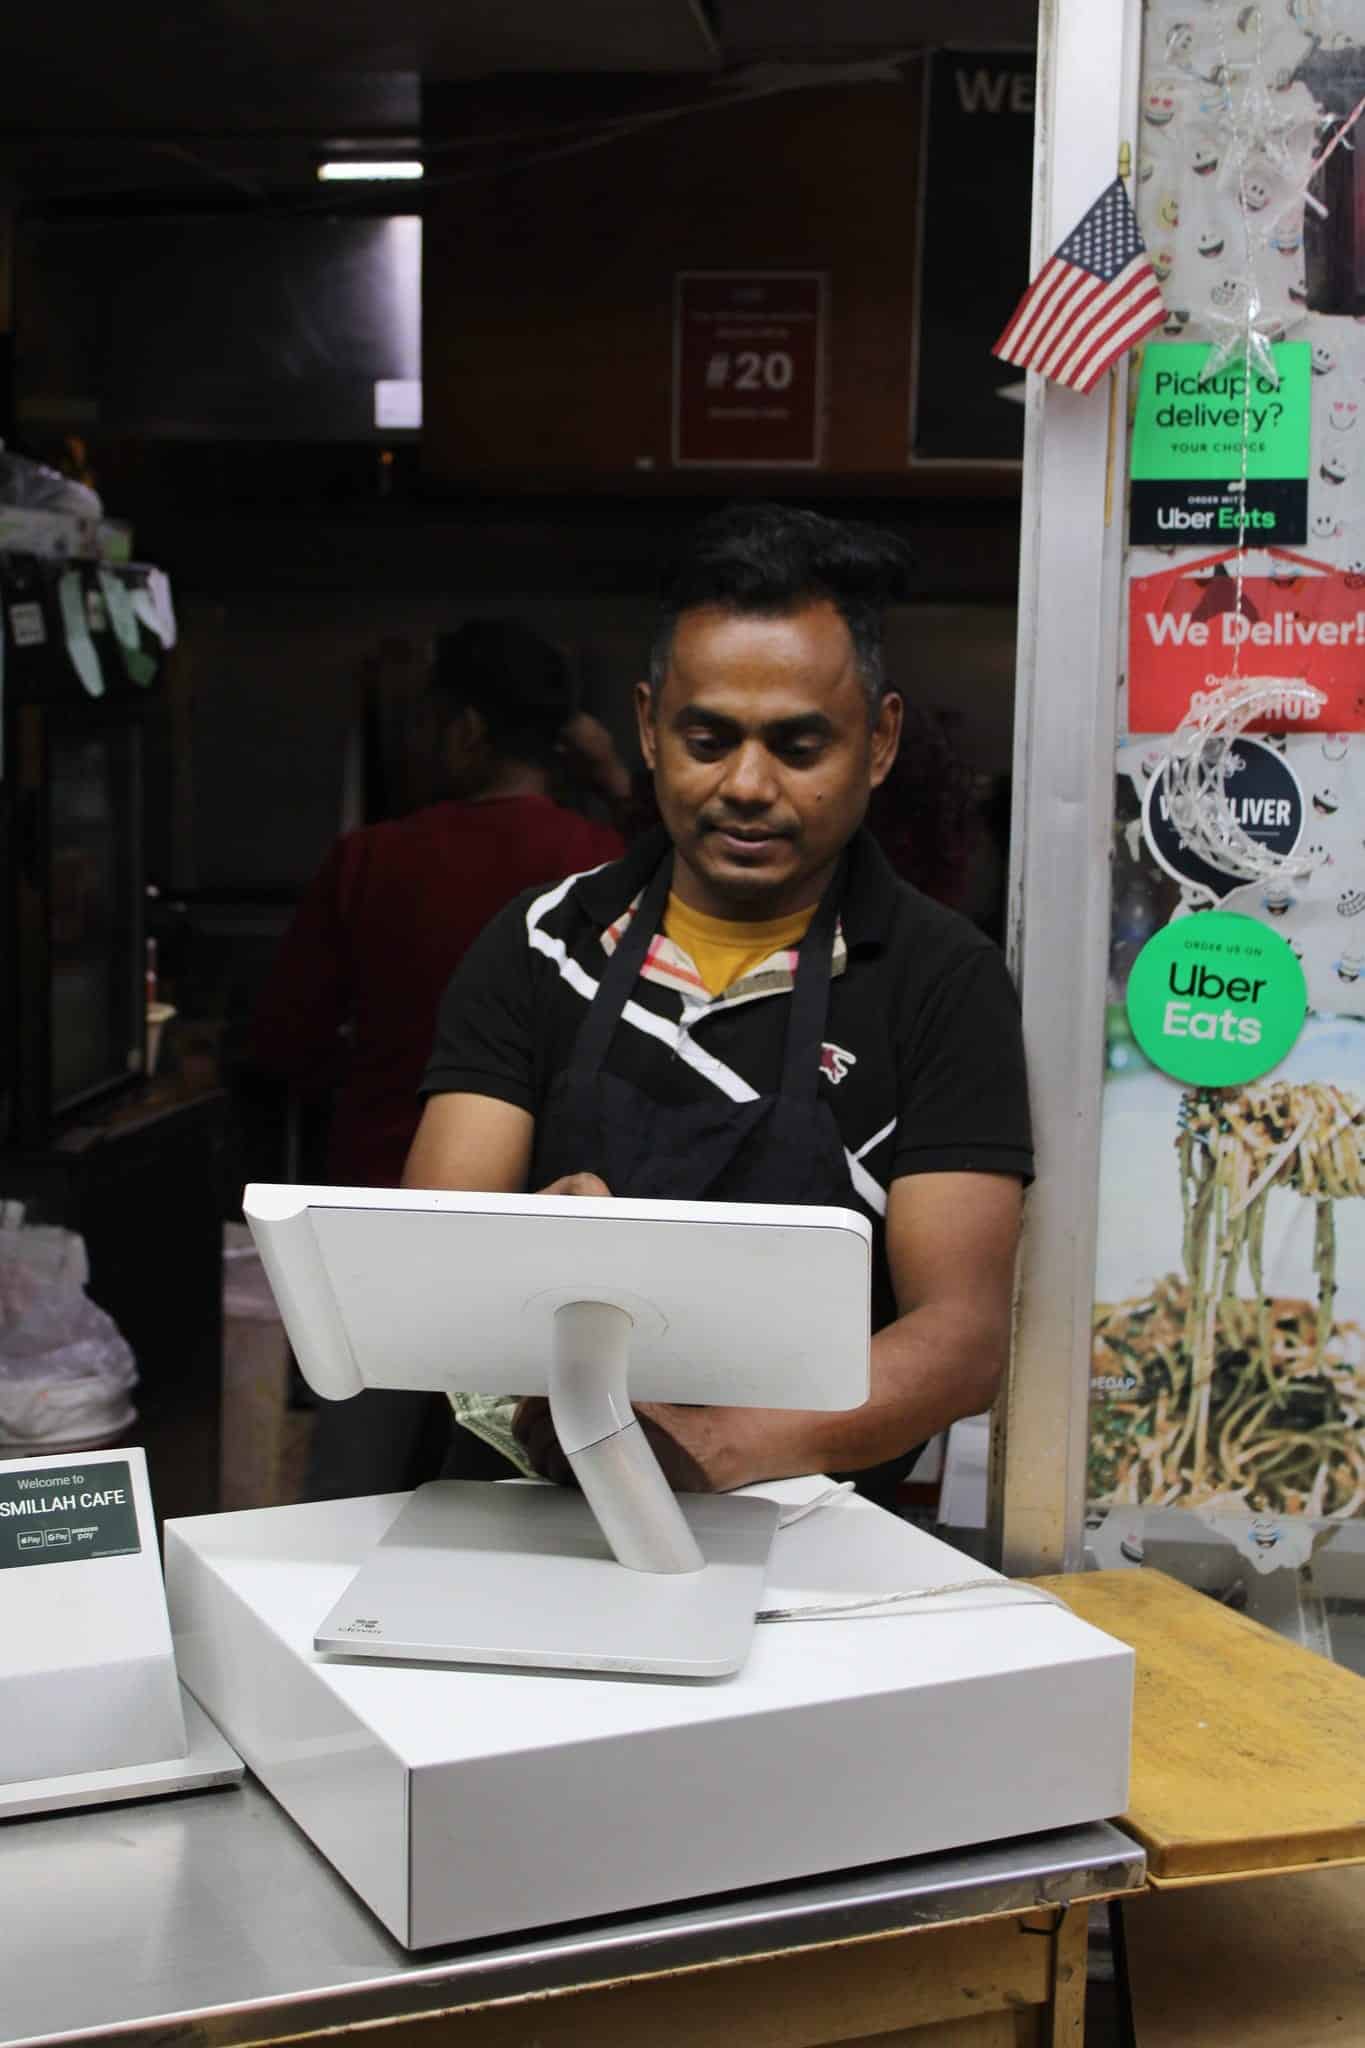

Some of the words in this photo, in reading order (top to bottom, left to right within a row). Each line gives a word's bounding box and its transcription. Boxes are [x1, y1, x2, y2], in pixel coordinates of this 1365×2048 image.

[705, 351, 794, 391] #20
[1155, 372, 1247, 400] Pickup
[1156, 403, 1283, 432] delivery?
[1171, 443, 1208, 453] YOUR
[1157, 507, 1215, 529] Uber
[1218, 507, 1276, 529] Eats
[1146, 612, 1210, 646] We
[1222, 611, 1365, 646] Deliver!
[1184, 940, 1222, 953] ORDER
[1226, 944, 1241, 954] US
[1245, 946, 1262, 957] ON
[1168, 961, 1267, 1004] Uber
[1162, 1001, 1262, 1046] Eats
[17, 1476, 71, 1490] Welcome
[72, 1474, 85, 1485] to
[0, 1494, 77, 1518] SMILLAH
[80, 1488, 127, 1508] CAFE
